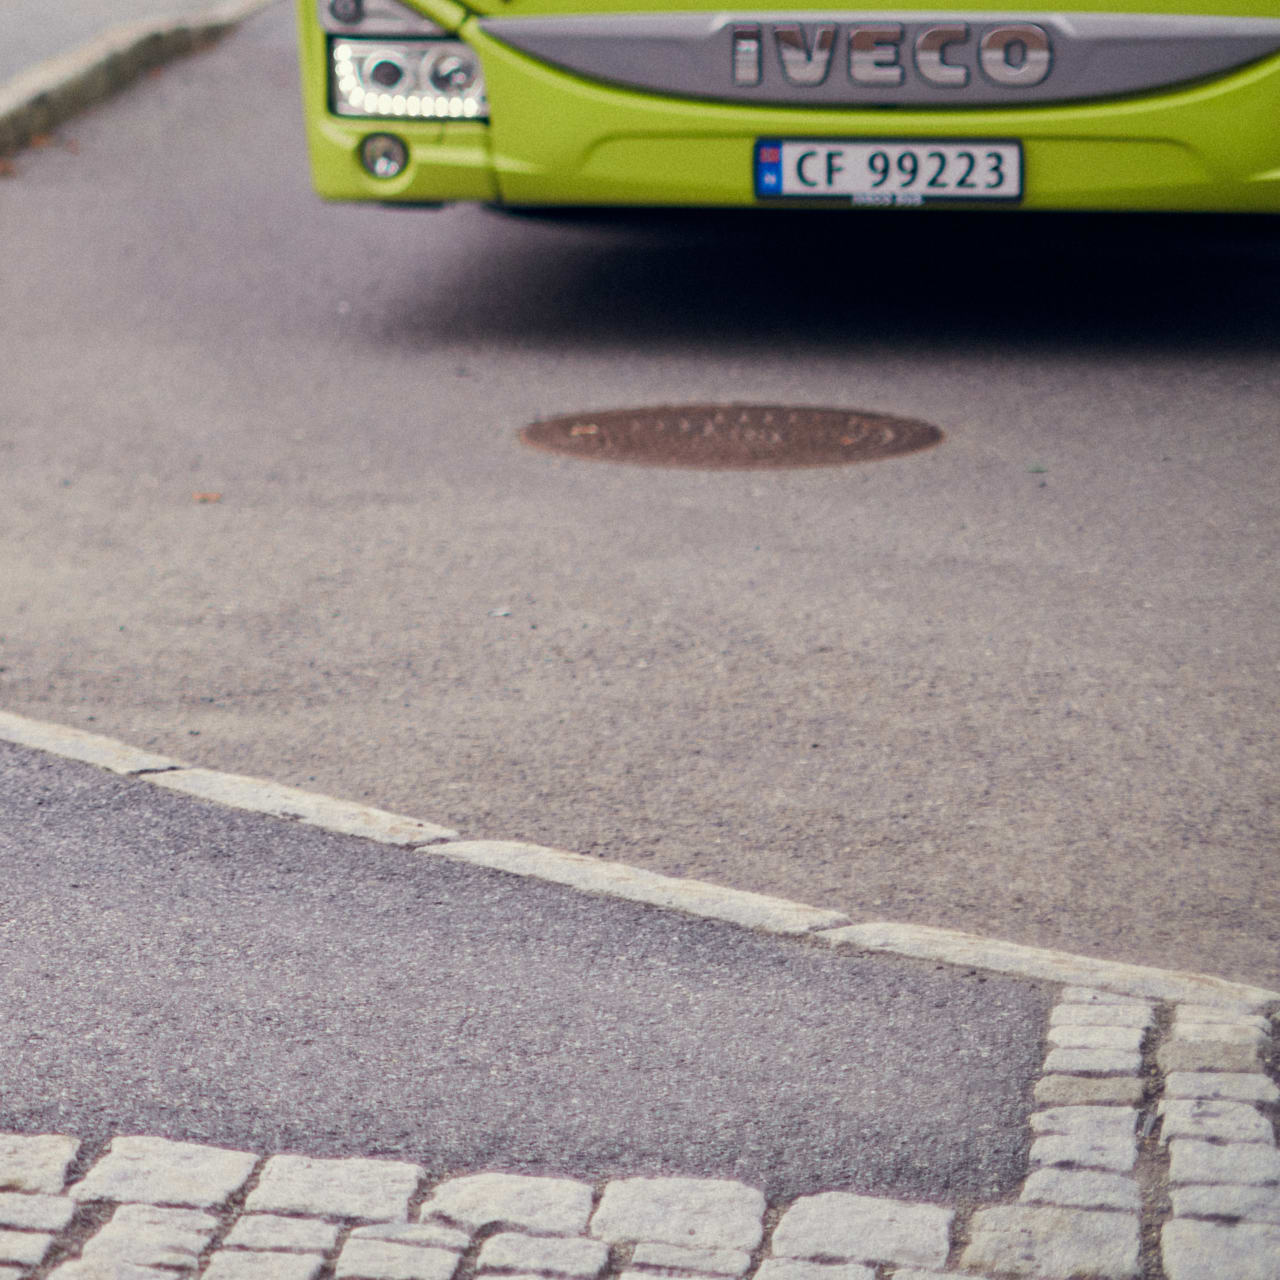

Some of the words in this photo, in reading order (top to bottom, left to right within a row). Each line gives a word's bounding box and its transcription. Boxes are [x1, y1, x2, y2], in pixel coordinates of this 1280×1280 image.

[733, 22, 1052, 86] IVECO
[796, 151, 843, 187] CF
[867, 151, 1004, 188] 99223
